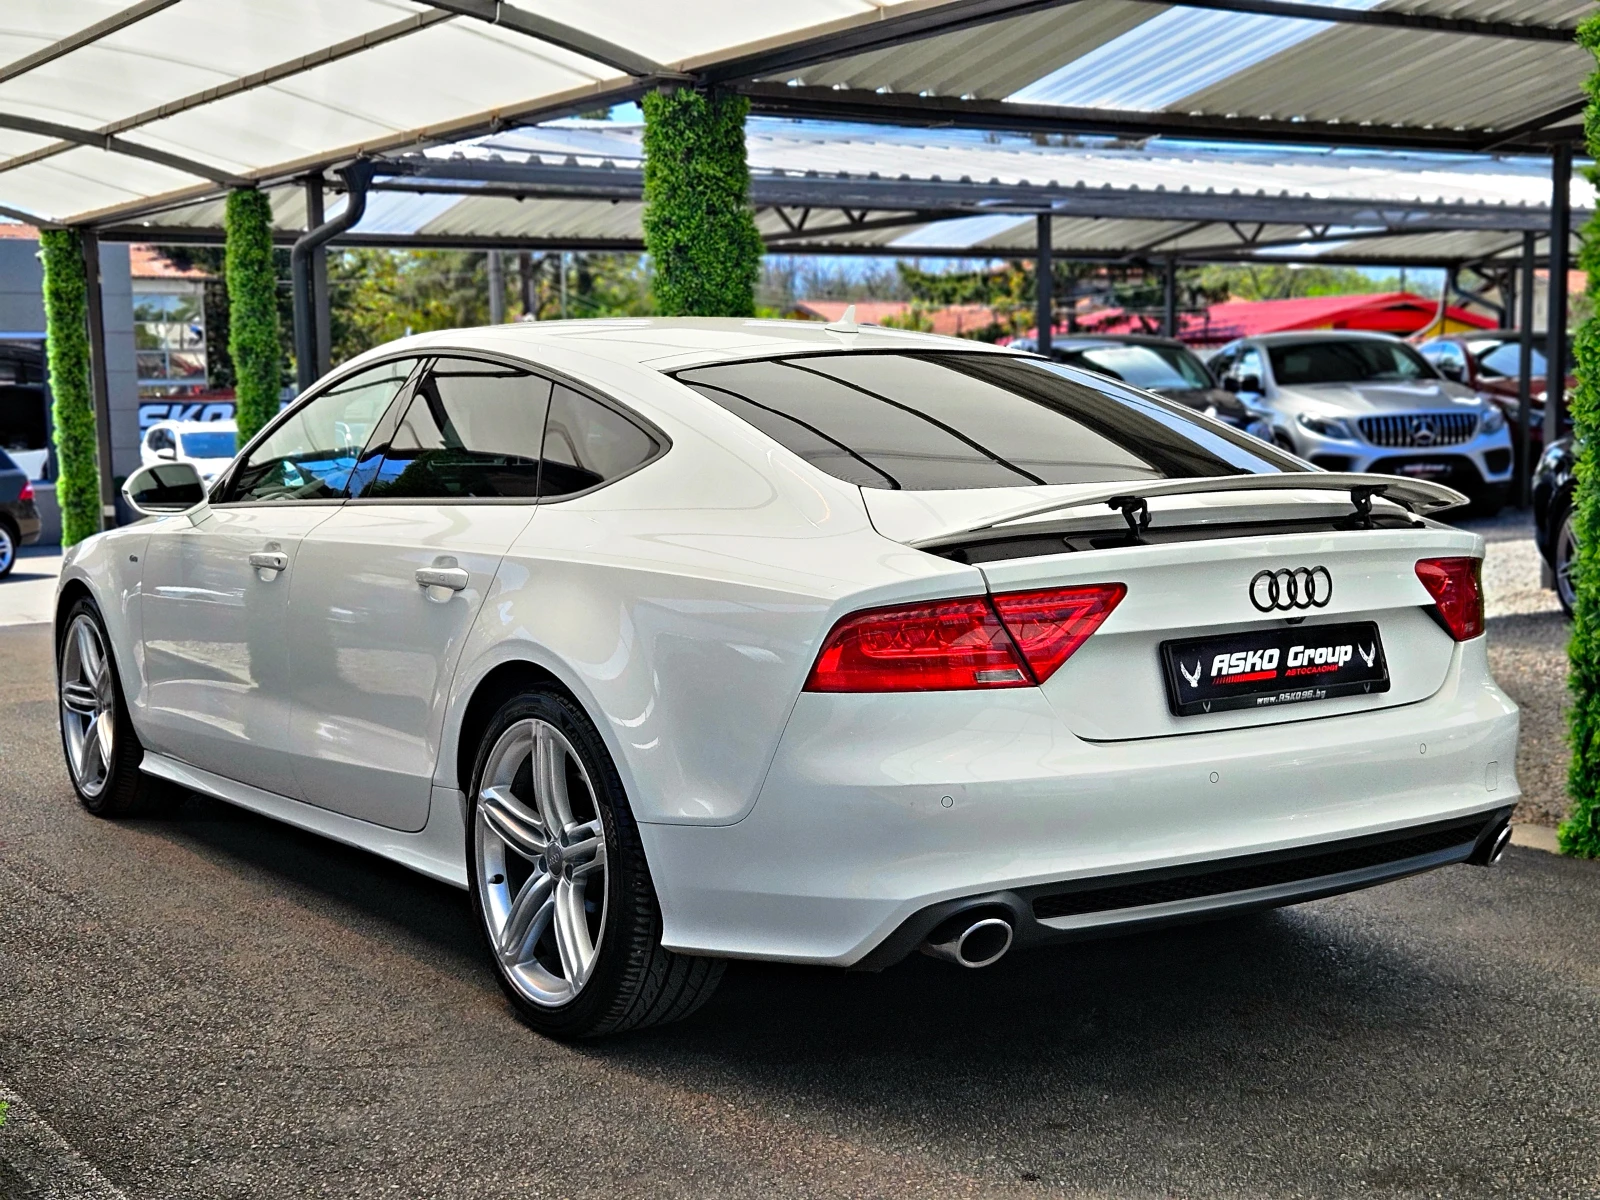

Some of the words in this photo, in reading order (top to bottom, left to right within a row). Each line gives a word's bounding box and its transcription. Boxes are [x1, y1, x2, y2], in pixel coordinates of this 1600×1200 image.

[1210, 648, 1280, 677] ASKO
[1287, 645, 1353, 667] Group
[1256, 688, 1327, 705] www.ASKO96.bg
